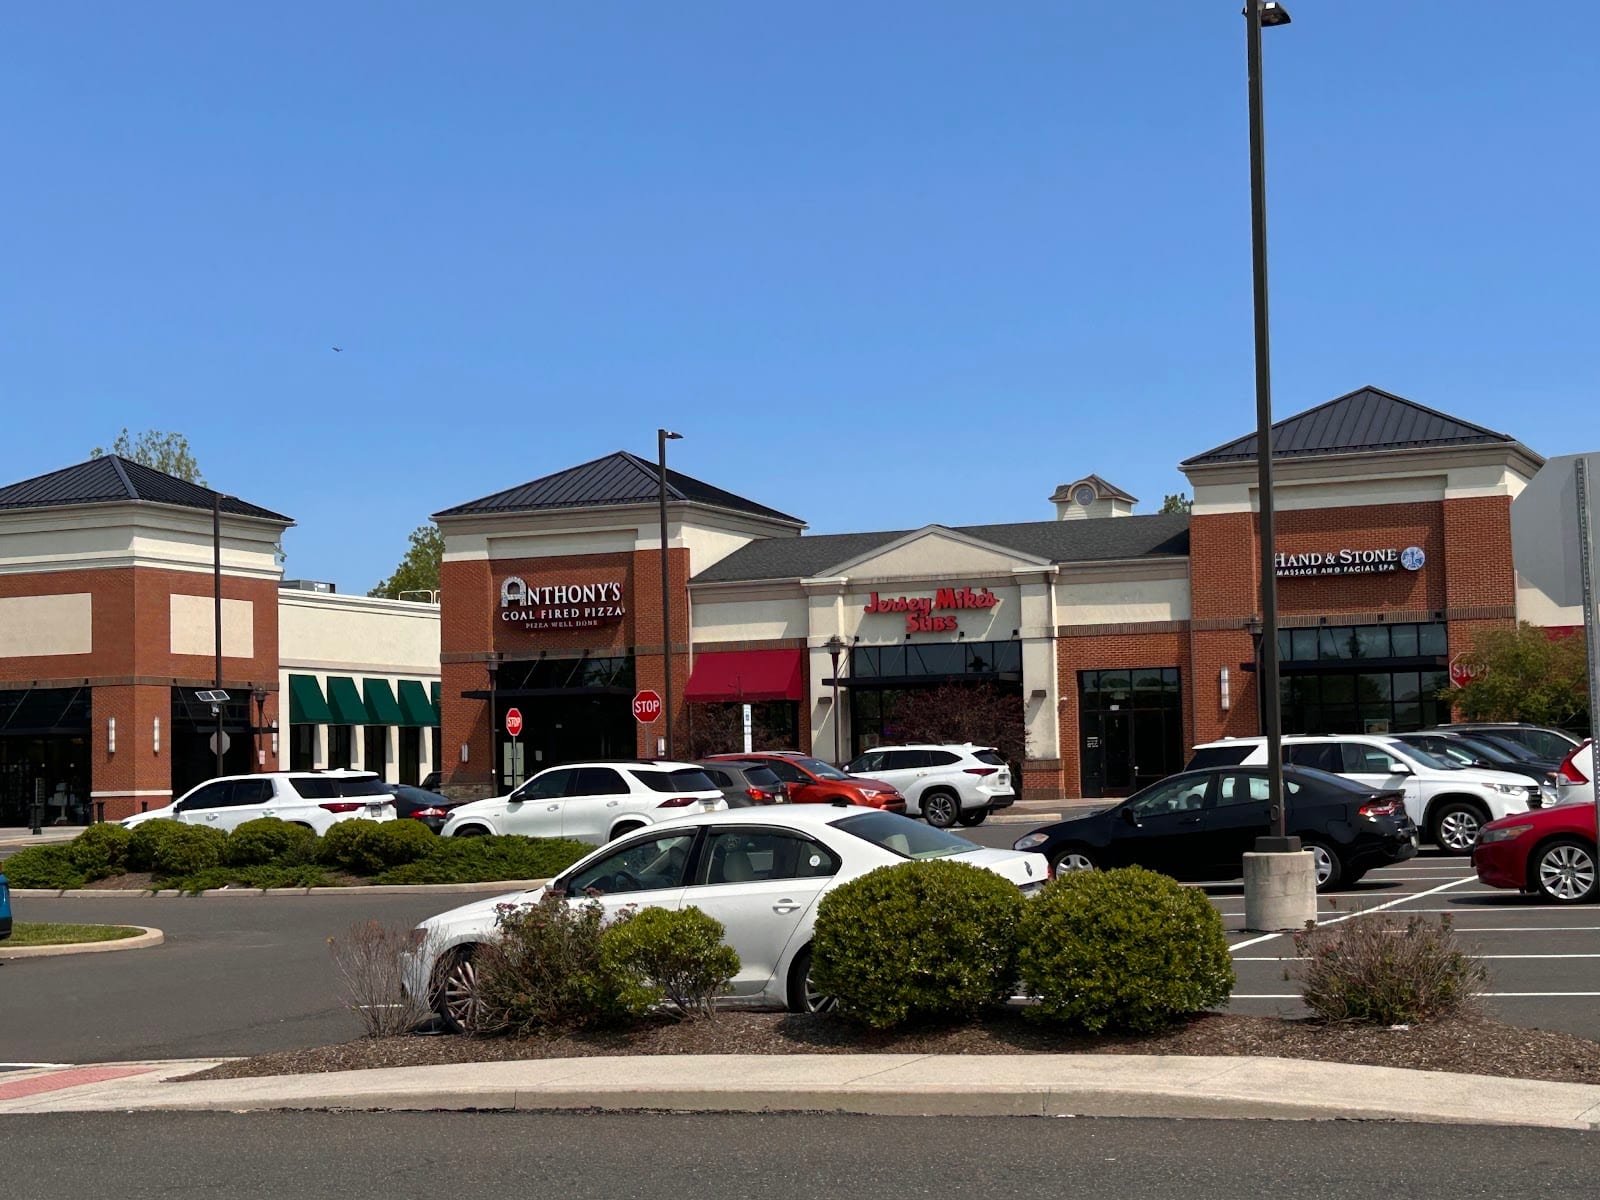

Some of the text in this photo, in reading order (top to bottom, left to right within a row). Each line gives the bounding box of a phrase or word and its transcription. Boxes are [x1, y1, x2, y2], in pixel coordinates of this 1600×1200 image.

[1275, 549, 1398, 567] HAND & STONE
[1276, 568, 1317, 576] MASSAGE
[1343, 564, 1375, 573] FACIAL
[501, 576, 621, 607] ANTHONY'S
[864, 587, 1000, 616] Jersey Mike's
[502, 606, 623, 621] COAL FIRED PIZZA
[1453, 663, 1485, 678] STOP
[635, 700, 660, 713] STOP
[508, 716, 521, 727] STOP
